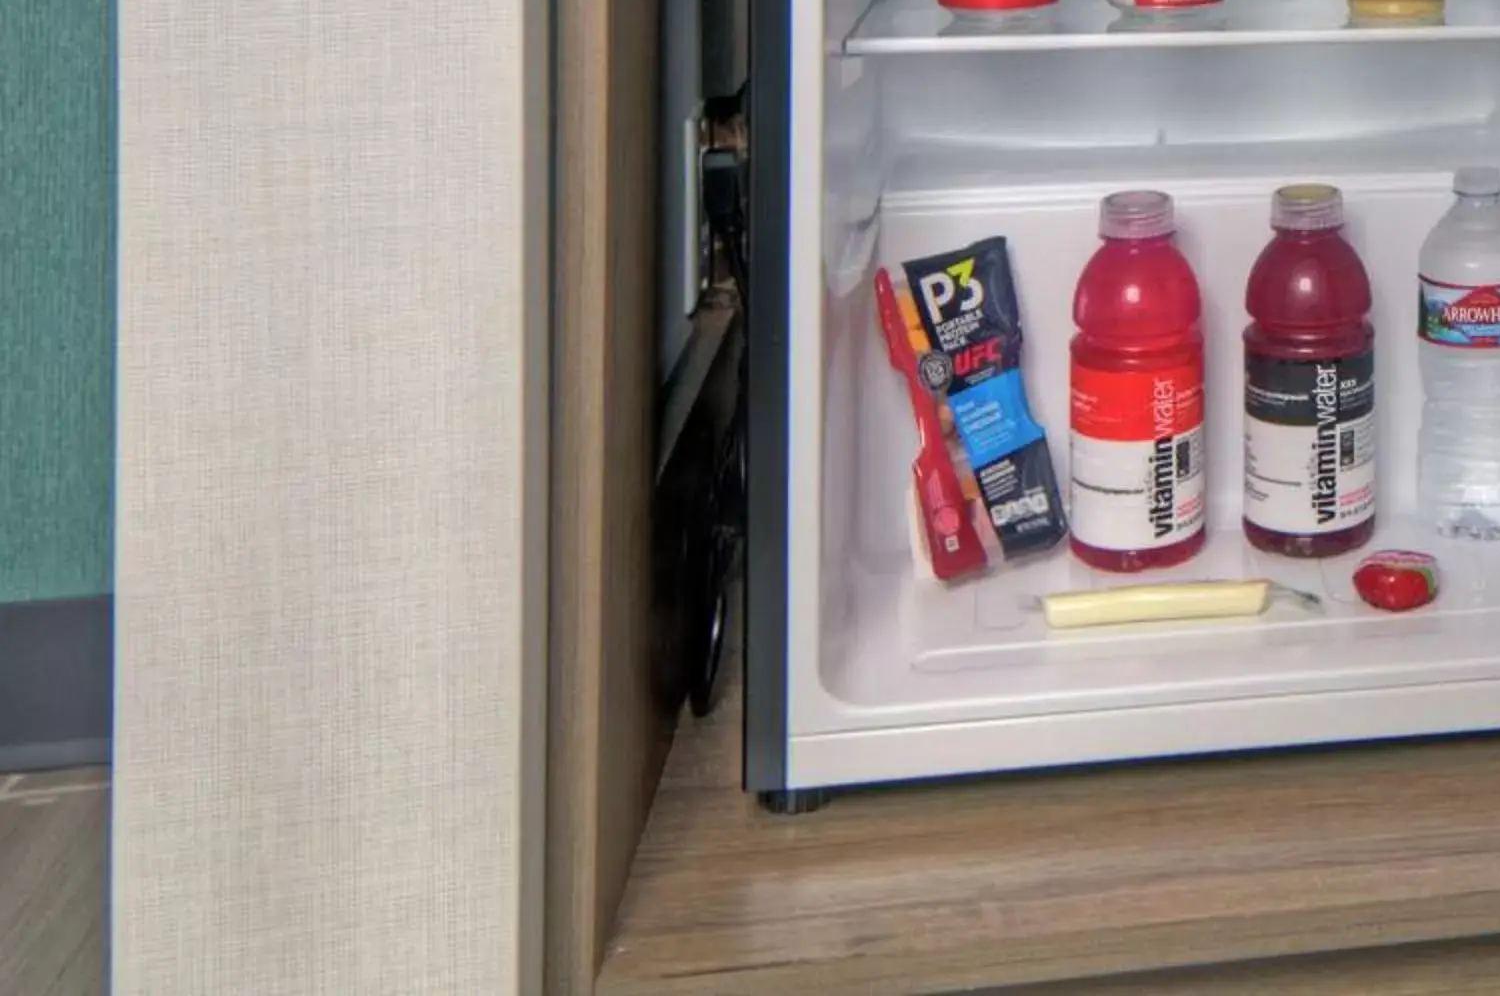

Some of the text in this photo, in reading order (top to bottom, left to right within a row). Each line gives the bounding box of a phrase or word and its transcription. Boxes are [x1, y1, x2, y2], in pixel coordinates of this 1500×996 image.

[920, 258, 984, 324] P3
[955, 337, 1004, 375] UFC
[1149, 378, 1174, 538] vitaminwater
[1312, 364, 1338, 525] vitaminwater
